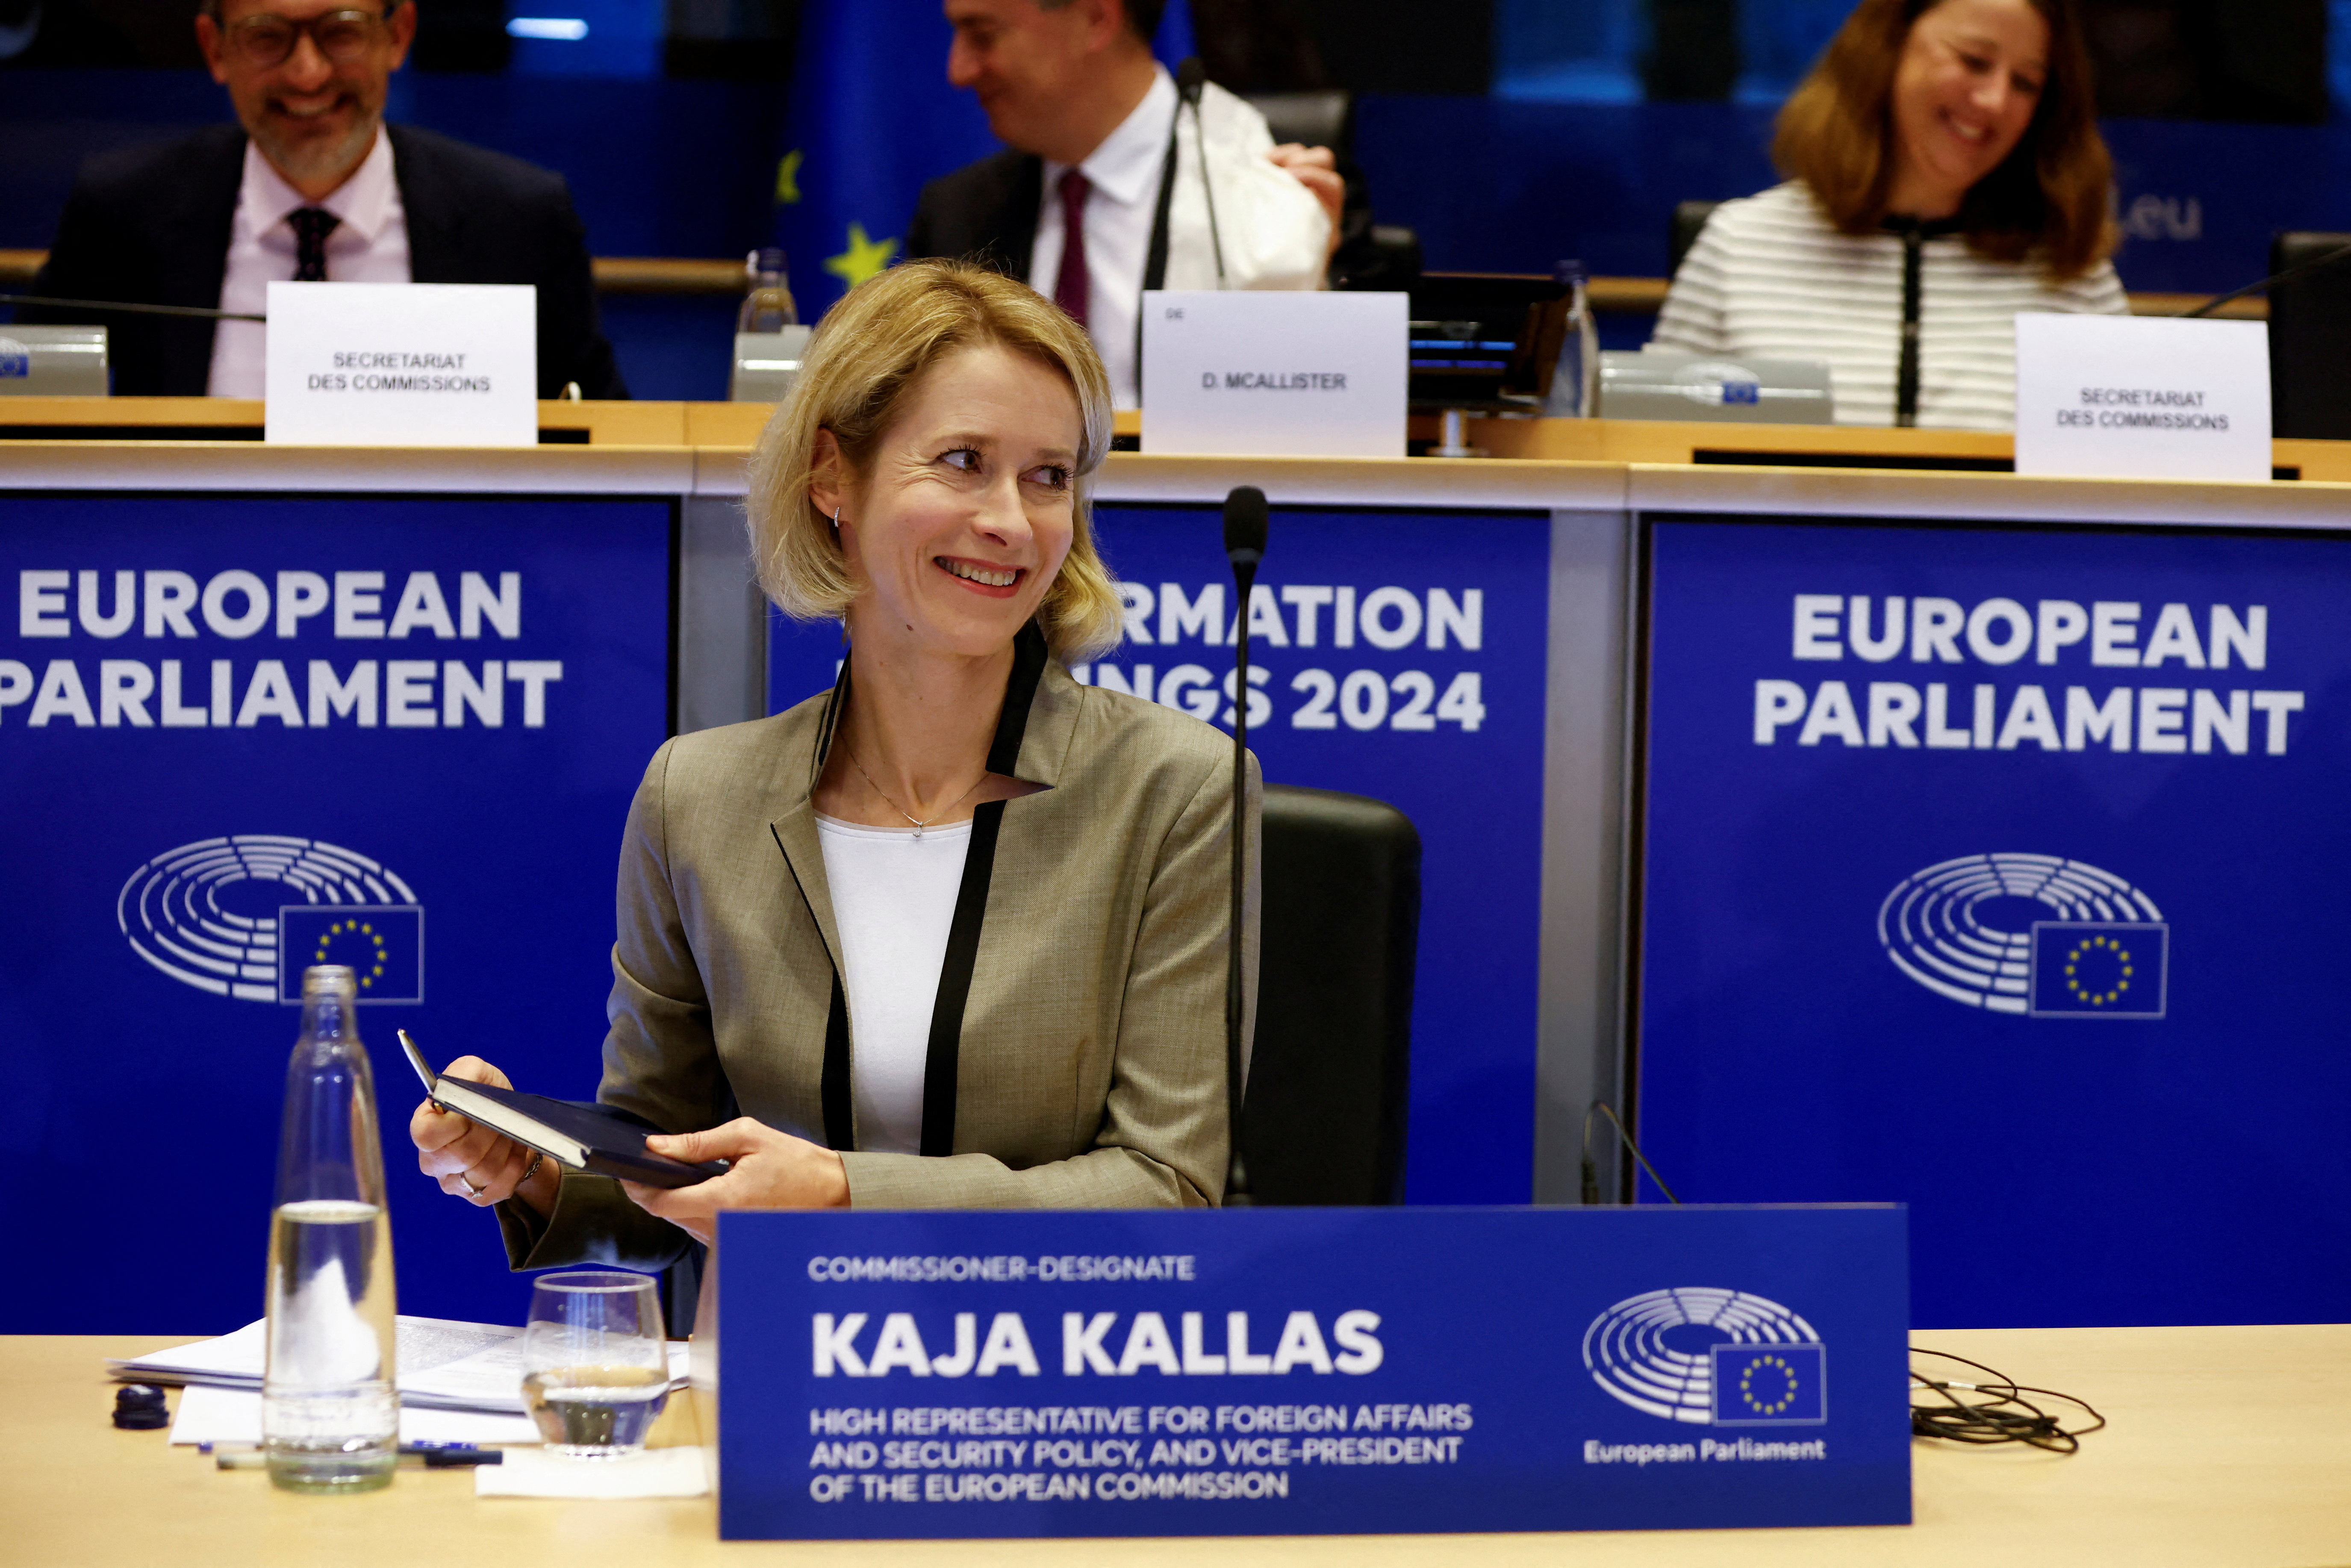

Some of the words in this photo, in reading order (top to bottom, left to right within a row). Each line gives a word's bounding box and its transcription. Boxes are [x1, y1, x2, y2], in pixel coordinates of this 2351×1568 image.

[333, 352, 465, 369] SECRETARIAT
[308, 374, 346, 390] DES
[352, 374, 491, 392] COMMISSIONS
[1225, 372, 1346, 389] MCALLISTER
[2080, 388, 2205, 407] SECRETARIAT
[2056, 409, 2095, 427] DES
[2099, 410, 2230, 431] COMMISSIONS
[19, 569, 520, 639] EUROPEAN
[1111, 582, 1482, 650] RMATION
[1793, 594, 2267, 669] EUROPEAN
[0, 660, 563, 727] PARLIAMENT
[1291, 669, 1485, 731] 2024
[1754, 679, 2304, 755] PARLIAMENT
[807, 1255, 1196, 1282] COMMISSIONER-DESIGNATE
[812, 1313, 1040, 1378] KAJA
[1063, 1310, 1384, 1376] KALLAS
[810, 1408, 887, 1436] HIGH
[892, 1406, 1143, 1435] REPRESENTATIVE
[1149, 1406, 1210, 1434] FOR
[1216, 1405, 1348, 1433] FOREIGN
[1352, 1403, 1473, 1432] AFFAIRS
[809, 1441, 878, 1469] AND
[883, 1440, 1028, 1469] SECURITY
[1034, 1439, 1144, 1471] POLICY,
[1149, 1438, 1217, 1467] AND
[1221, 1436, 1464, 1466] VICE-PRESIDENT
[1583, 1440, 1696, 1466] European
[1700, 1437, 1826, 1462] Parliament
[810, 1474, 854, 1503] OF
[858, 1473, 919, 1502] THE
[925, 1472, 1090, 1502] EUROPEAN
[1095, 1471, 1289, 1500] COMMISSION
